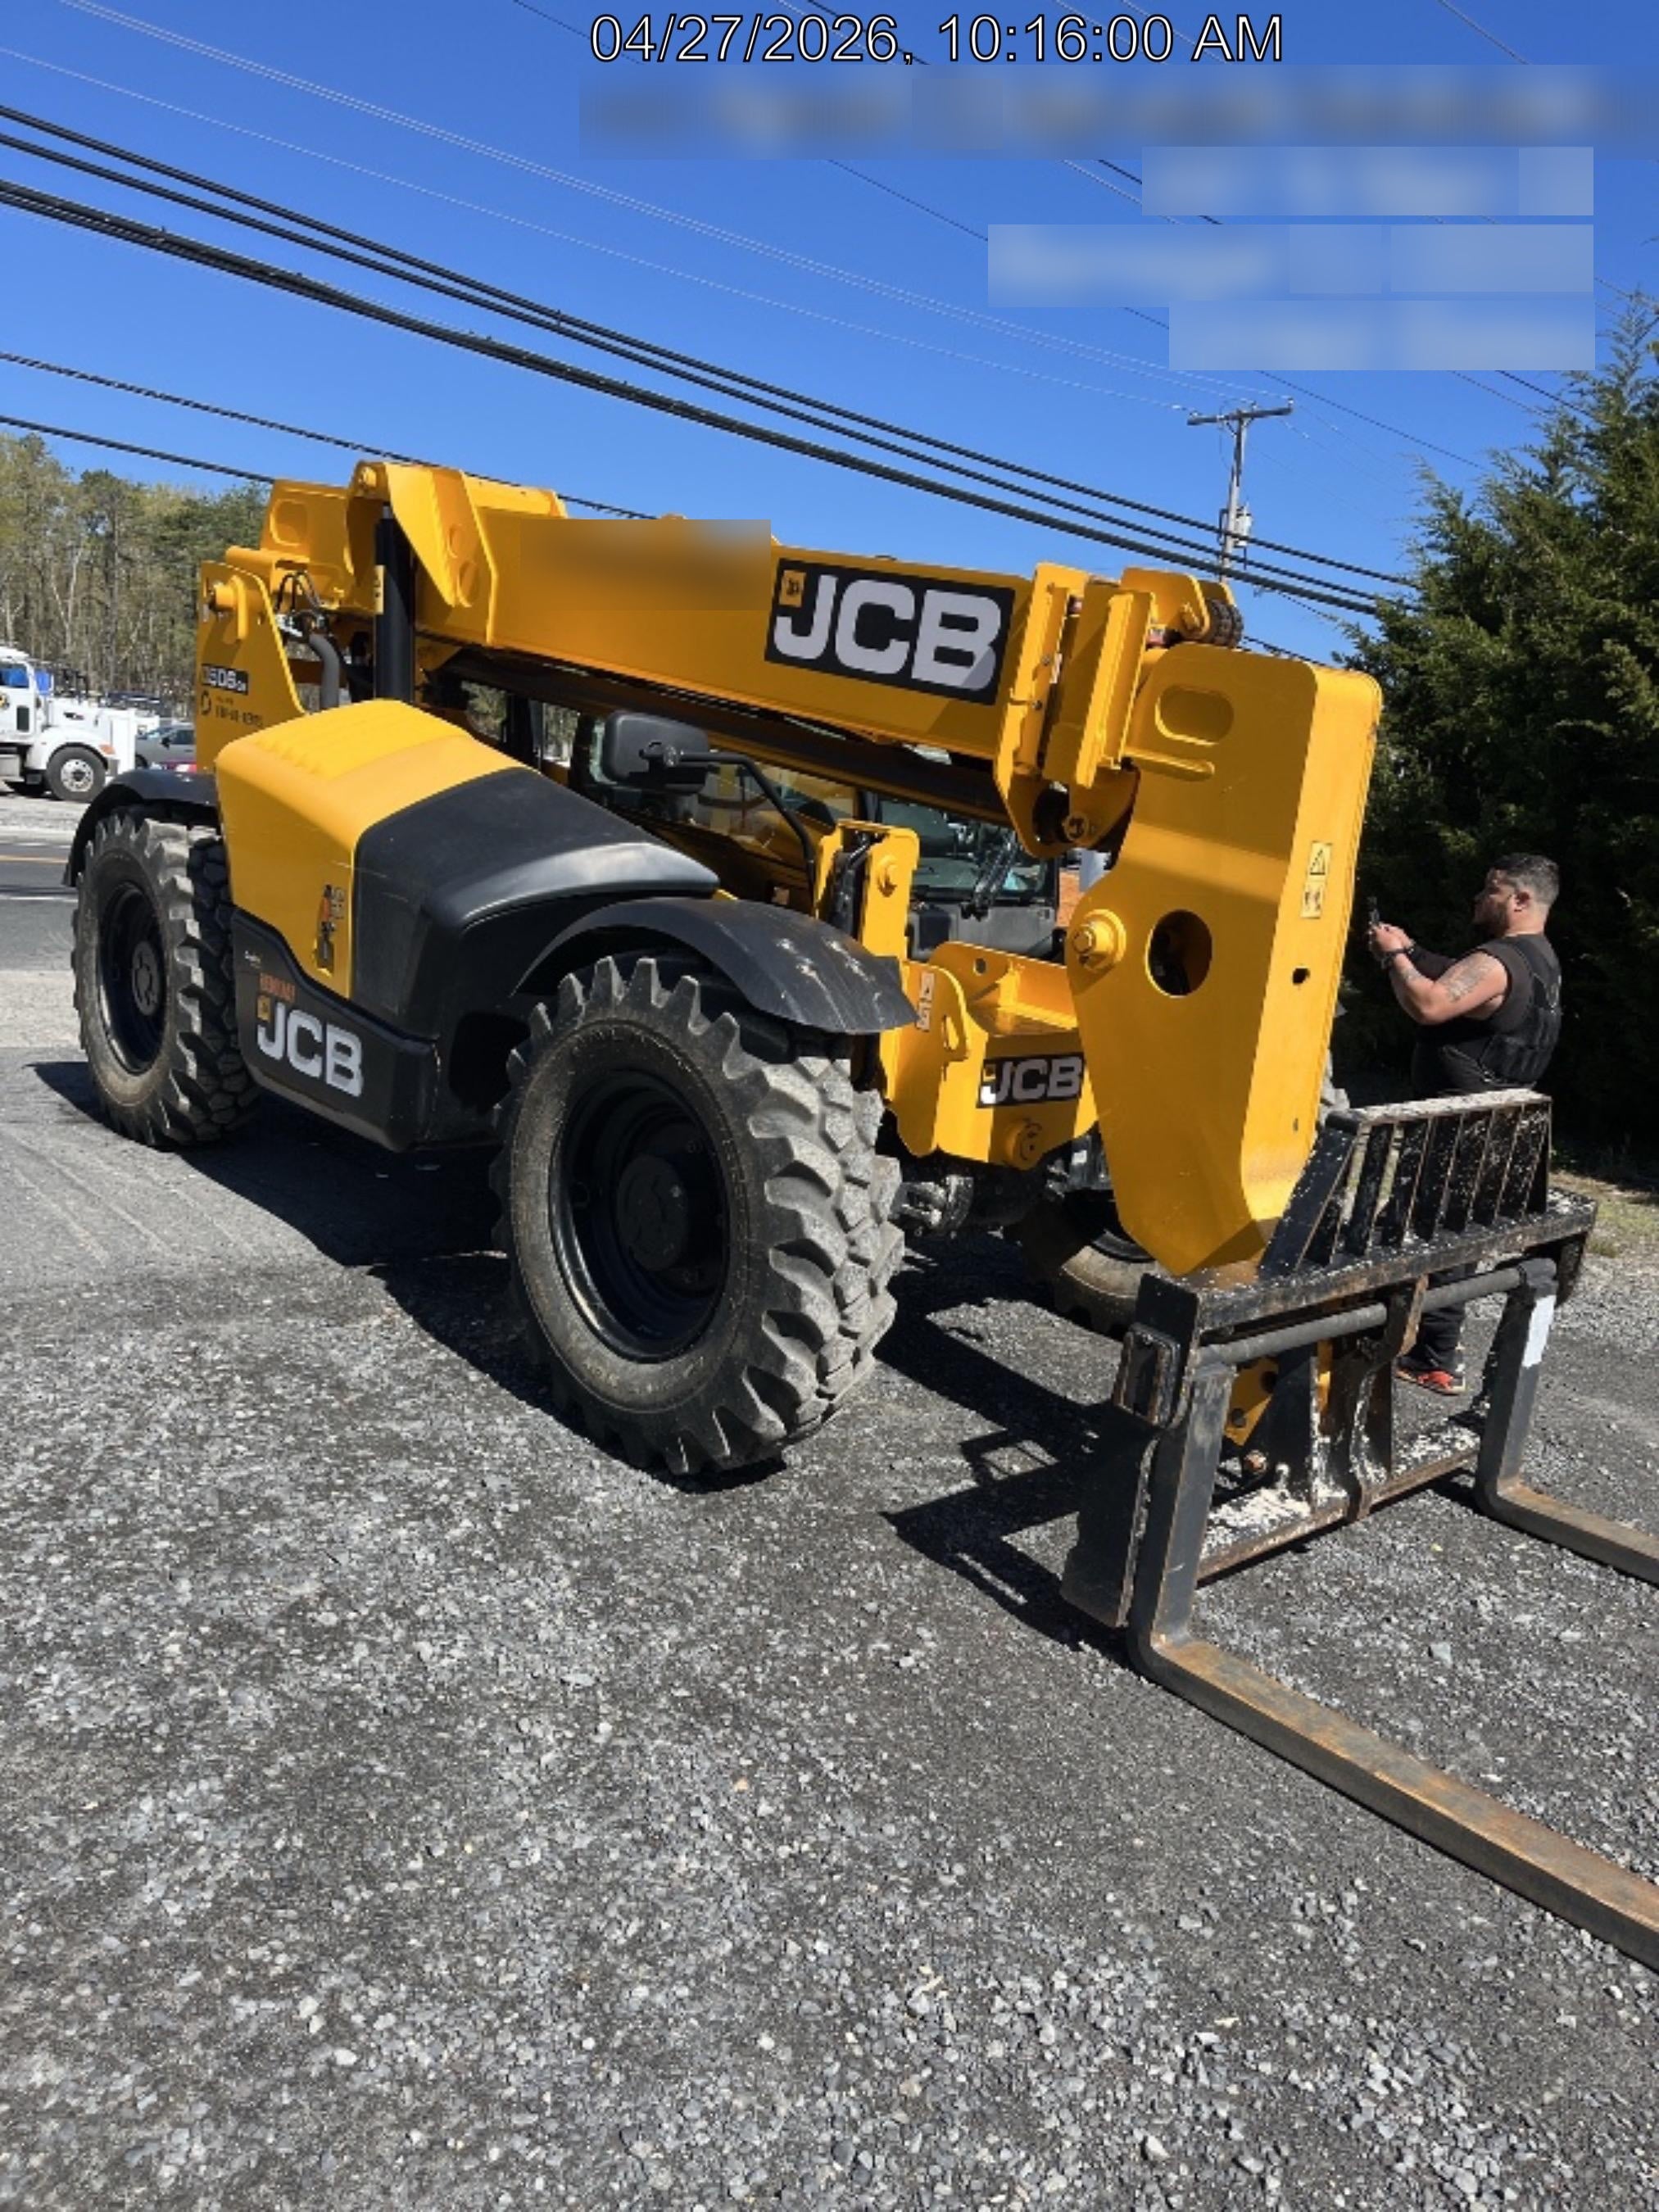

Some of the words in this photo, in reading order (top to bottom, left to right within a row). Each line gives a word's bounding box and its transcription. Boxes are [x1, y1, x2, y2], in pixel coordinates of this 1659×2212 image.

[774, 573, 1001, 691] JCB
[257, 1001, 364, 1098] JCB
[980, 1056, 1082, 1105] JCB
